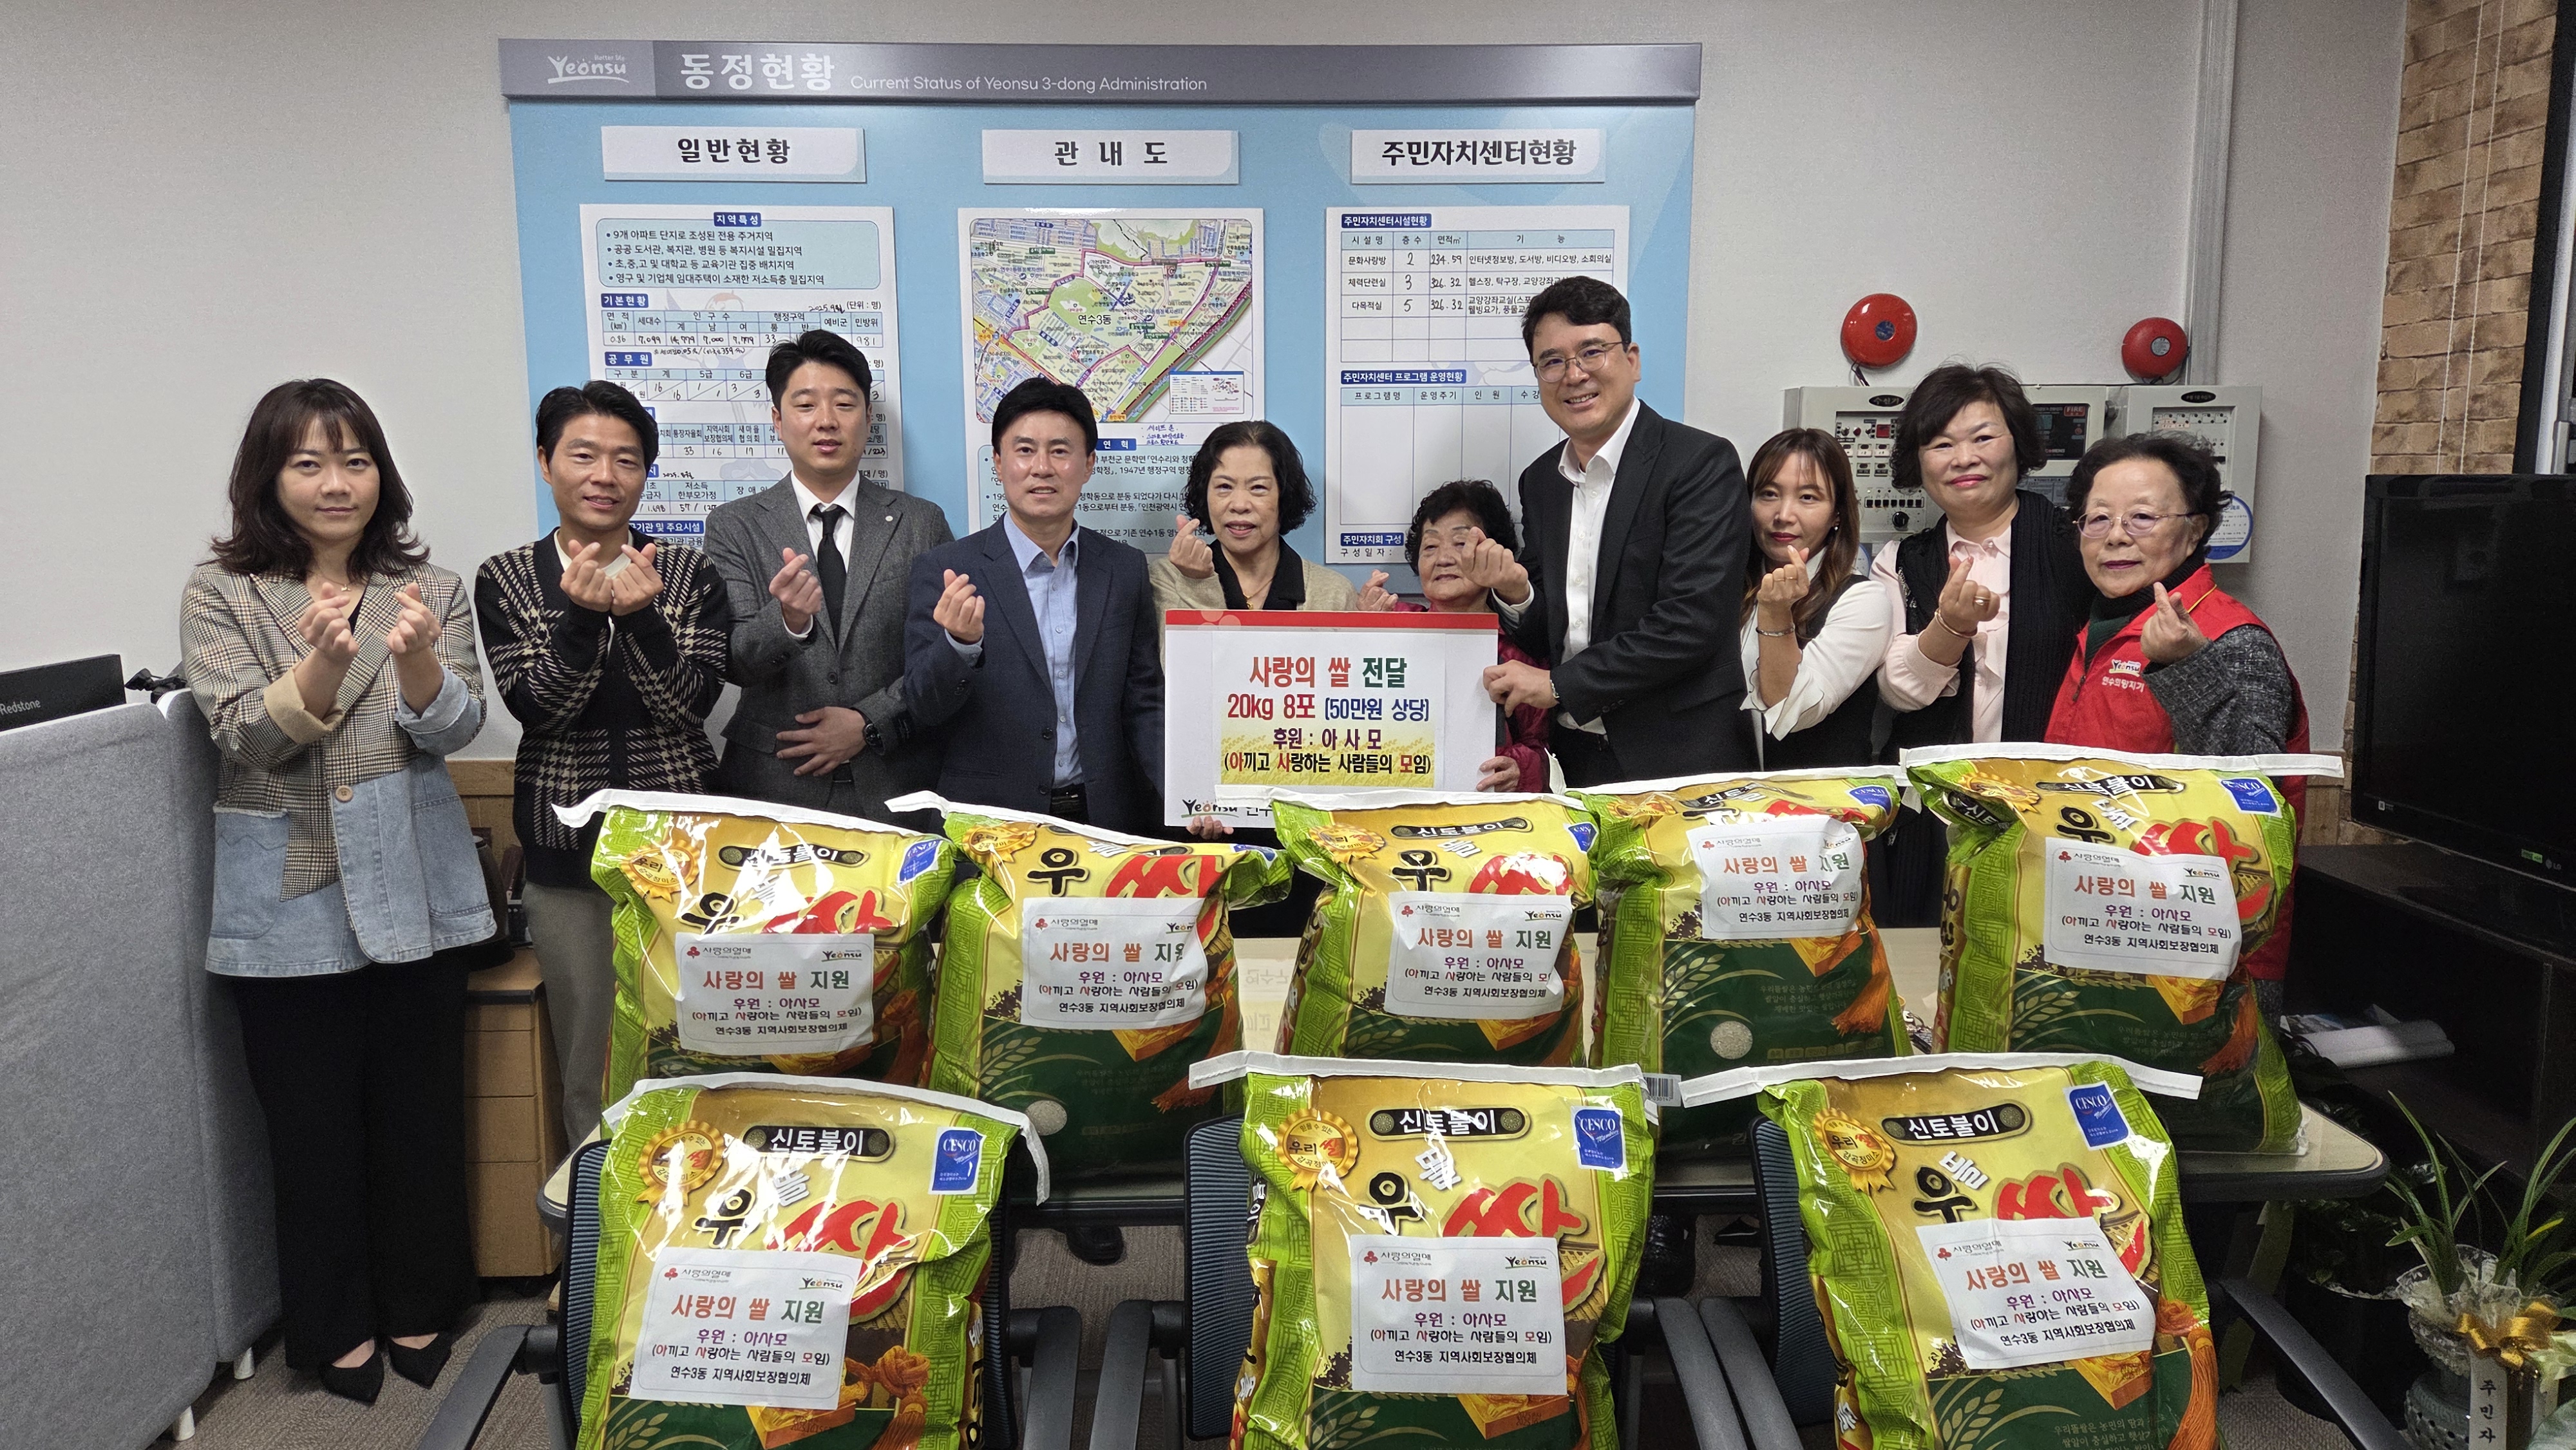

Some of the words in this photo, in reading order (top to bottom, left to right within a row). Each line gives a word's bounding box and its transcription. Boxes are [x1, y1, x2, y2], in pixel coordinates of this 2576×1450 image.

[547, 55, 627, 79] Yeonsu
[679, 53, 835, 91] 동정현황
[851, 75, 909, 90] Current
[913, 76, 962, 90] Status
[966, 76, 981, 90] of
[984, 76, 1039, 91] Yeonsu
[1042, 76, 1095, 94] 3-dong
[1100, 77, 1207, 91] Administration
[678, 138, 791, 164] 일반현황
[1382, 139, 1577, 166] 주민자치센터현황
[717, 214, 758, 225] 지역특성
[1344, 216, 1427, 227] 주민자치센터시설현황
[614, 231, 628, 240] 9개
[631, 231, 657, 240] 아파트
[659, 231, 687, 241] 단지로
[689, 231, 715, 241] 조성된
[718, 231, 735, 241] 전용
[738, 231, 773, 241] 주거지역
[614, 245, 631, 254] 공공
[635, 245, 663, 255] 도서관,
[699, 245, 715, 256] 병원
[719, 246, 726, 256] 등
[730, 245, 764, 256] 복지시설
[616, 259, 647, 268] 초,중,고
[650, 259, 658, 269] 및
[661, 259, 688, 269] 대학교
[690, 260, 699, 269] 등
[702, 260, 736, 270] 교육기관
[759, 260, 793, 270] 배치지역
[1349, 256, 1387, 265] 문화사랑방
[1406, 252, 1414, 265] 2
[1519, 256, 1544, 264] 도서방,
[1546, 255, 1579, 264] 비디오방,
[1582, 254, 1611, 263] 소회의실
[616, 274, 633, 283] 영구
[636, 274, 645, 283] 및
[648, 274, 673, 283] 기업체
[677, 274, 721, 284] 임대주택이
[724, 274, 749, 284] 소재한
[752, 275, 786, 284] 저소득층
[1349, 278, 1386, 287] 체력단련실
[1405, 274, 1412, 290] 3
[1496, 277, 1520, 286] 탁구장,
[603, 296, 646, 306] 기본현황
[1352, 301, 1382, 310] 다목적실
[1404, 299, 1413, 312] 5
[824, 318, 848, 327] 예비군
[855, 318, 878, 327] 민방위
[1078, 314, 1111, 326] 연수3동
[765, 334, 775, 343] 33
[857, 337, 875, 346] 981
[1343, 372, 1392, 382] 주민자치센터
[1395, 372, 1427, 382] 프로그램
[1430, 371, 1463, 382] 운영현황
[1343, 535, 1383, 545] 주민자치회
[1385, 534, 1402, 544] 구성
[1249, 657, 1314, 688] 사랑의
[1328, 657, 1350, 688] 쌀
[1362, 657, 1407, 688] 전달
[0, 700, 41, 716] Redstone
[1227, 693, 1273, 720] 20kg
[1283, 693, 1316, 718] 8포
[1273, 728, 1302, 749] 후원
[1224, 753, 1270, 772] (아끼고
[1277, 753, 1331, 773] 사랑하는
[1338, 753, 1392, 774] 사람들의
[1400, 755, 1431, 774] 모임)
[2074, 876, 2136, 897] 사랑의
[2149, 881, 2167, 899] 쌀
[2179, 884, 2215, 904] 지원
[1418, 928, 1472, 948] 사랑의
[1486, 930, 1503, 948] 쌀
[1515, 930, 1551, 949] 지원
[2085, 934, 2121, 946] 연수3동
[2127, 937, 2219, 954] 지역사회보장협의체
[703, 970, 763, 990] 사랑의
[778, 971, 797, 990] 쌀
[810, 970, 849, 989] 지원
[1424, 986, 1457, 996] 연수3동
[715, 1026, 751, 1035] 연수3동
[757, 1023, 847, 1035] 지역사회보장협의체
[2075, 1095, 2109, 1111] CESCO
[1580, 1118, 1615, 1131] CESCO
[1908, 1110, 1999, 1140] 신토불이
[771, 1129, 864, 1155] 신토불이
[943, 1139, 976, 1153] CESCO
[1289, 1140, 1317, 1154] 우리
[1831, 1133, 1857, 1149] 우리
[1966, 1262, 2030, 1291] 사랑의
[2038, 1260, 2061, 1281] 쌀
[2067, 1259, 2108, 1278] 지원
[1382, 1279, 1446, 1302] 사랑의
[1461, 1279, 1481, 1302] 쌀
[1495, 1280, 1537, 1302] 지원
[2007, 1294, 2036, 1310] 후원
[2052, 1288, 2095, 1303] 아사모
[671, 1294, 736, 1319] 사랑의
[749, 1298, 770, 1321] 쌀
[781, 1300, 824, 1323] 지원
[2066, 1302, 2109, 1317] 사람들의
[1414, 1312, 1443, 1327] 후원
[1463, 1313, 1507, 1327] 아사모
[697, 1329, 725, 1344] 후원
[744, 1332, 787, 1346] 아사모
[1416, 1331, 1463, 1342] 사랑하는
[1471, 1331, 1517, 1343] 사람들의
[2000, 1331, 2039, 1346] 연수3동
[2043, 1319, 2136, 1341] 지역사회보장협의체
[696, 1347, 741, 1361] 사랑하는
[747, 1349, 795, 1363] 사람들의
[1395, 1350, 1433, 1363] 연수3동
[1439, 1351, 1537, 1364] 지역사회보장협의체
[670, 1366, 707, 1380] 연수3동
[712, 1368, 811, 1385] 지역사회보장협의체
